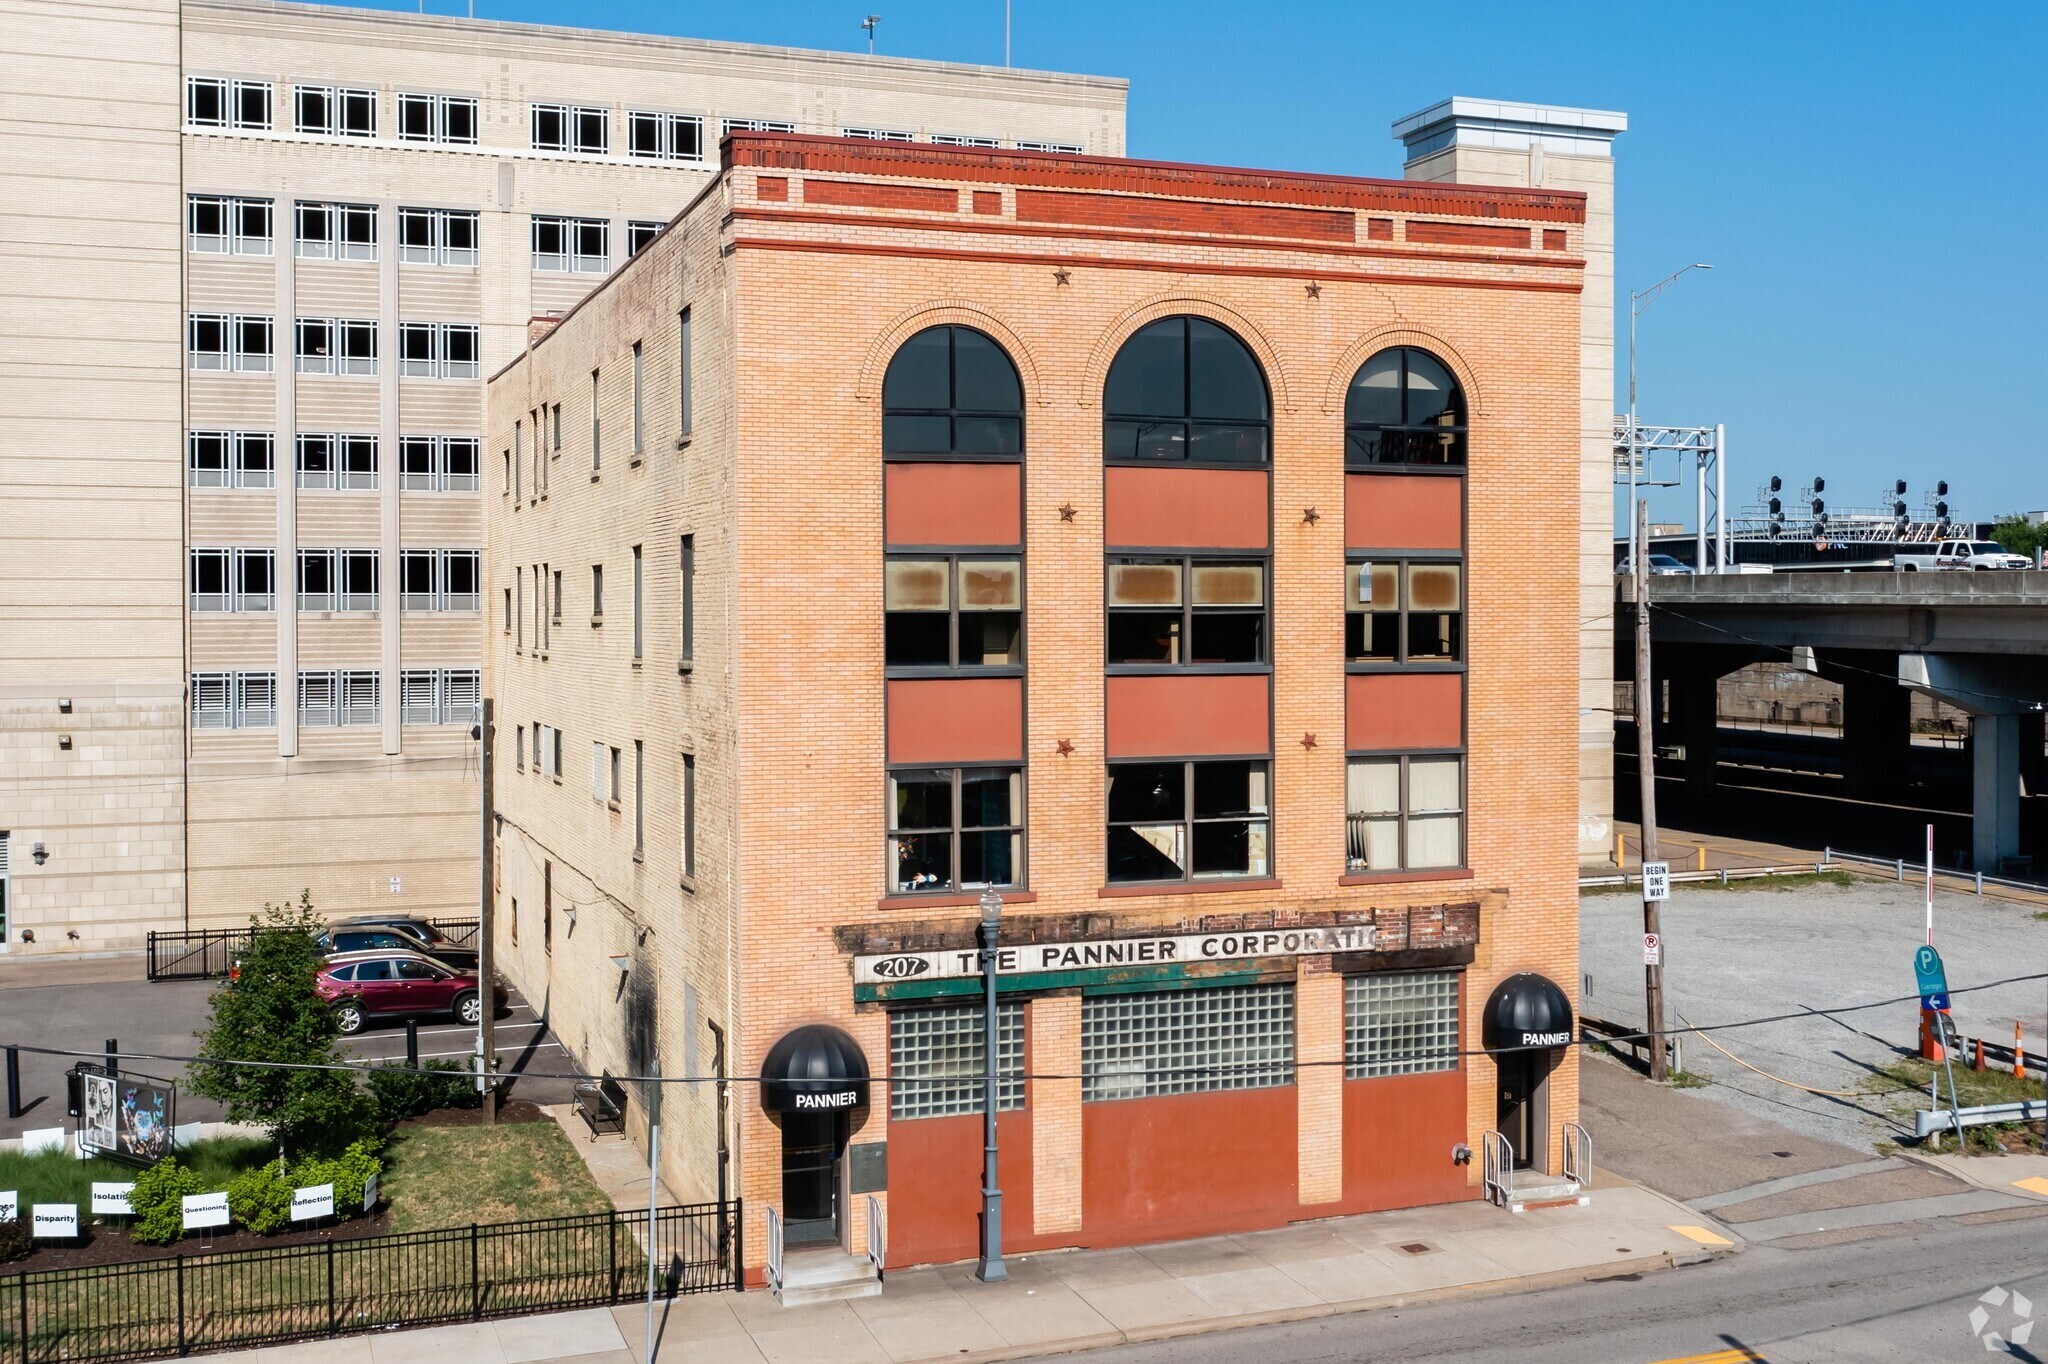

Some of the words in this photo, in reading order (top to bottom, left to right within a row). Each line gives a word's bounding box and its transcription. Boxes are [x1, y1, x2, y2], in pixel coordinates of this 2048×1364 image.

[1645, 866, 1666, 876] BEGIN
[1649, 876, 1663, 886] ONE
[1649, 887, 1665, 898] WAY
[883, 957, 920, 977] 207
[1042, 940, 1176, 968] PANNIER
[1920, 950, 1932, 969] P
[1920, 982, 1943, 991] Garage
[1522, 1031, 1570, 1046] PANNIER
[795, 1091, 857, 1108] PANNIER
[93, 1192, 129, 1201] Isolatio
[292, 1194, 332, 1207] Reflection
[184, 1203, 227, 1214] Questioning
[35, 1214, 76, 1223] Disparity
